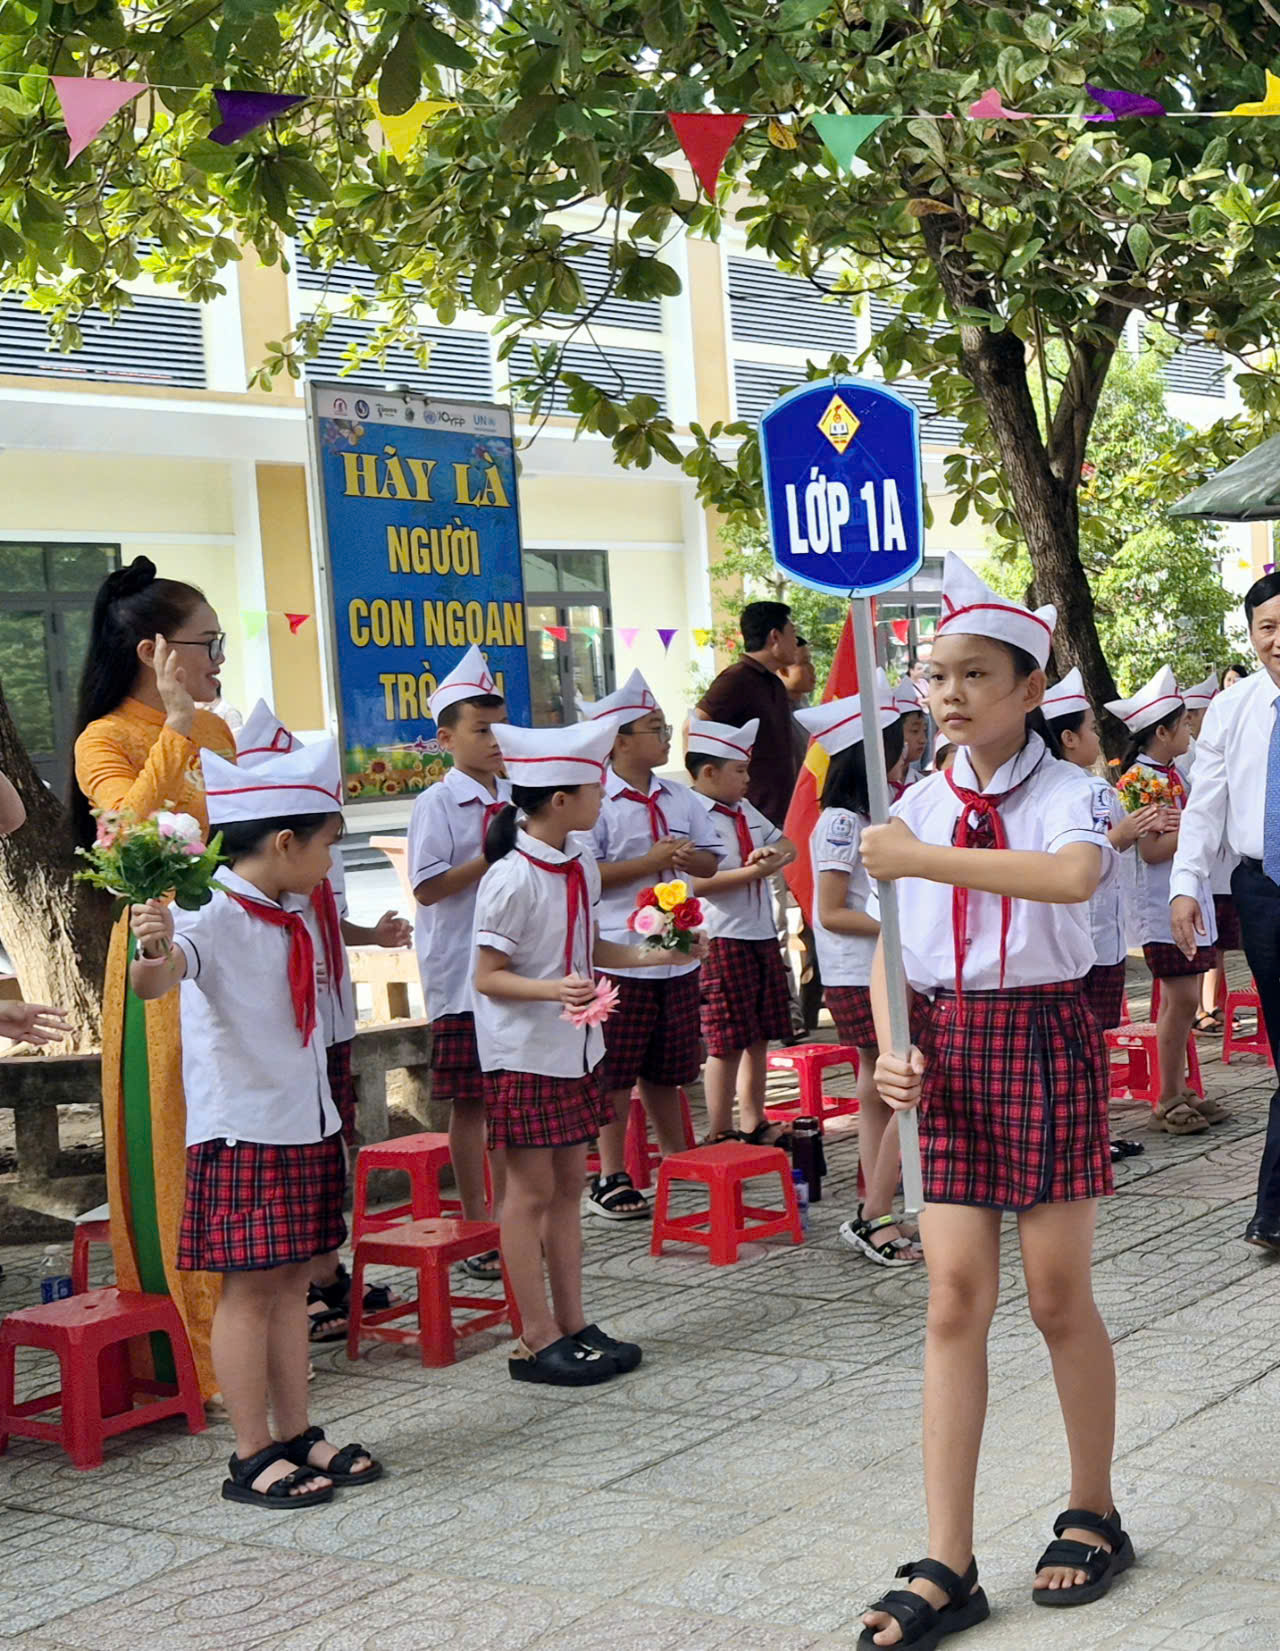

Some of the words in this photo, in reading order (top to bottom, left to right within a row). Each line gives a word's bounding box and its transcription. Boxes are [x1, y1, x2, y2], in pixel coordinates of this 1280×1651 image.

[339, 444, 438, 501] HÃY
[451, 451, 512, 507] LÀ
[785, 466, 850, 554] LỚP
[860, 478, 907, 552] 1A
[386, 516, 481, 575] NGƯỜI
[348, 598, 415, 647] CON
[422, 600, 526, 647] NGOAN
[379, 661, 437, 720] TRÒ
